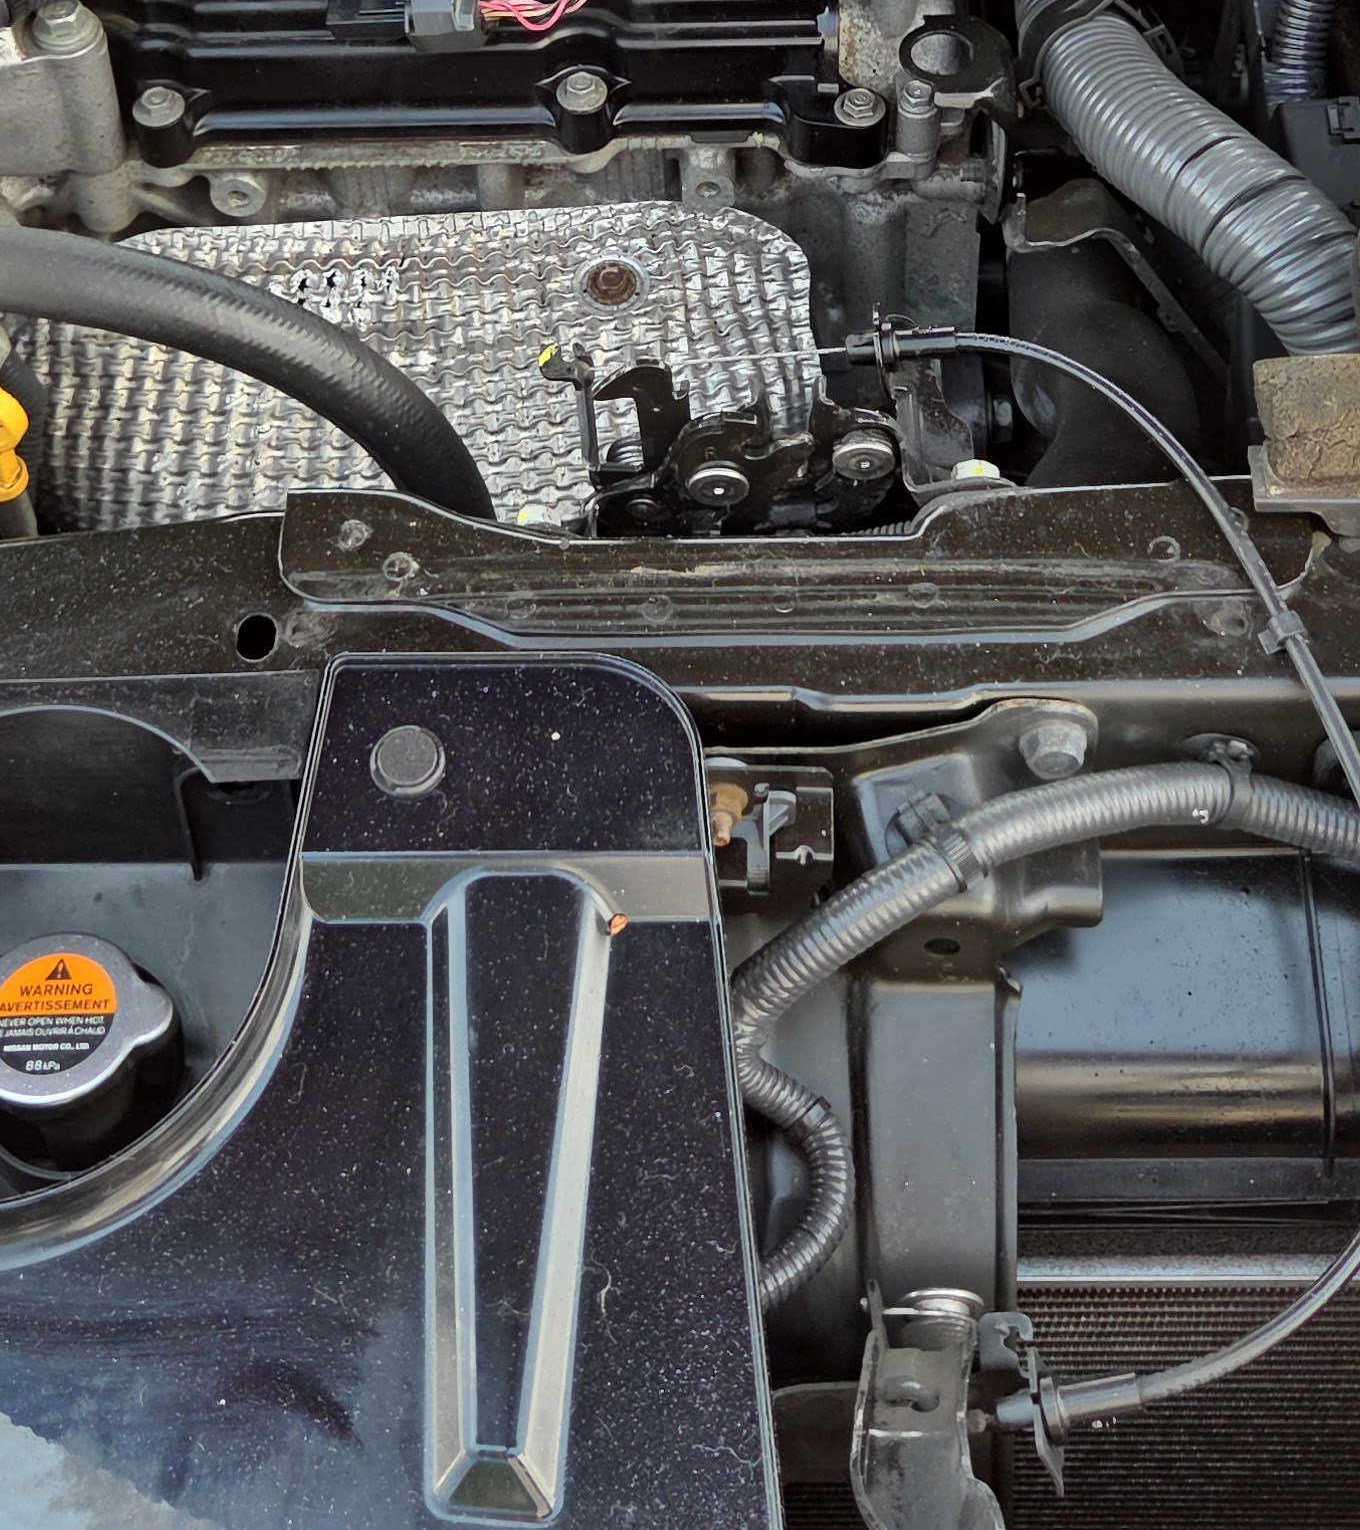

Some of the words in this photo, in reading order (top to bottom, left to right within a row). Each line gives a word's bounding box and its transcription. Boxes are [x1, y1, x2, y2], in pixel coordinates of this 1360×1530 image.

[19, 983, 93, 996] WARNING
[27, 1017, 53, 1026] OPEN
[55, 1016, 83, 1024] WHEN
[4, 1028, 34, 1036] JAMAIS
[34, 1027, 66, 1035] OUVRIR
[3, 1044, 31, 1052] NISSAN
